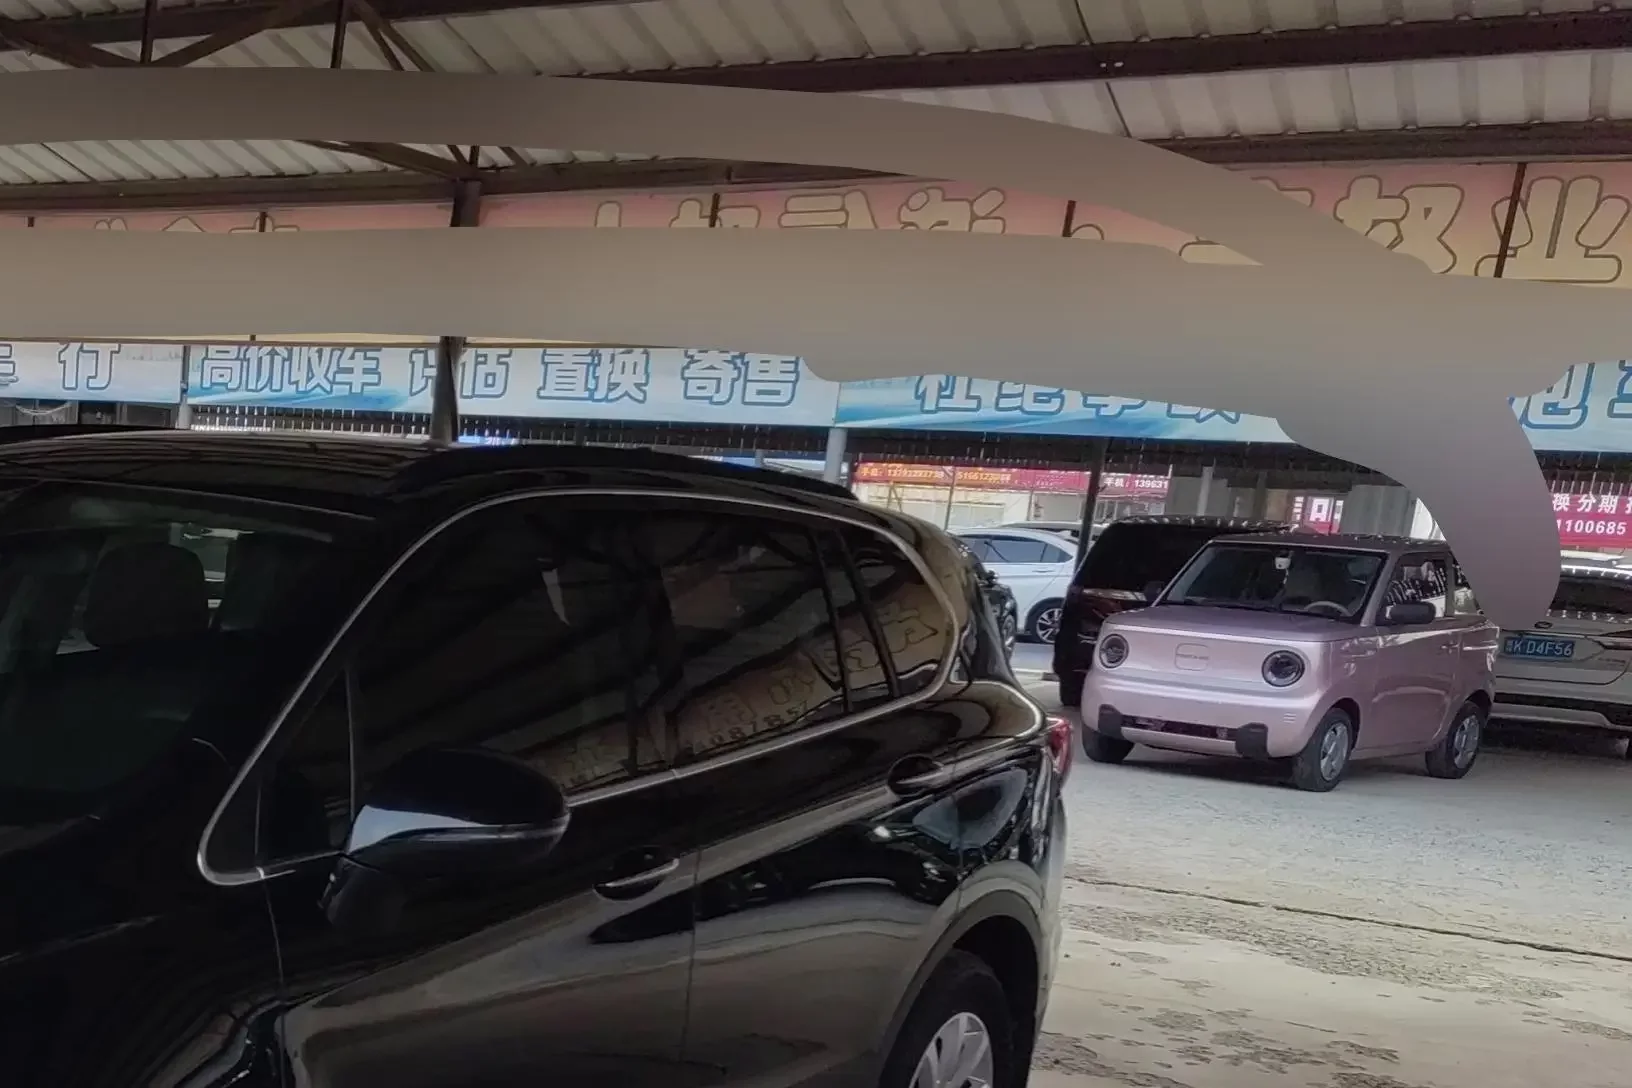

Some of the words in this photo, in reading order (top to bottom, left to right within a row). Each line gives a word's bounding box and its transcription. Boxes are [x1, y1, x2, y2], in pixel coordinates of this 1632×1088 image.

[201, 345, 381, 396] 高价收车
[537, 348, 651, 404] 置换
